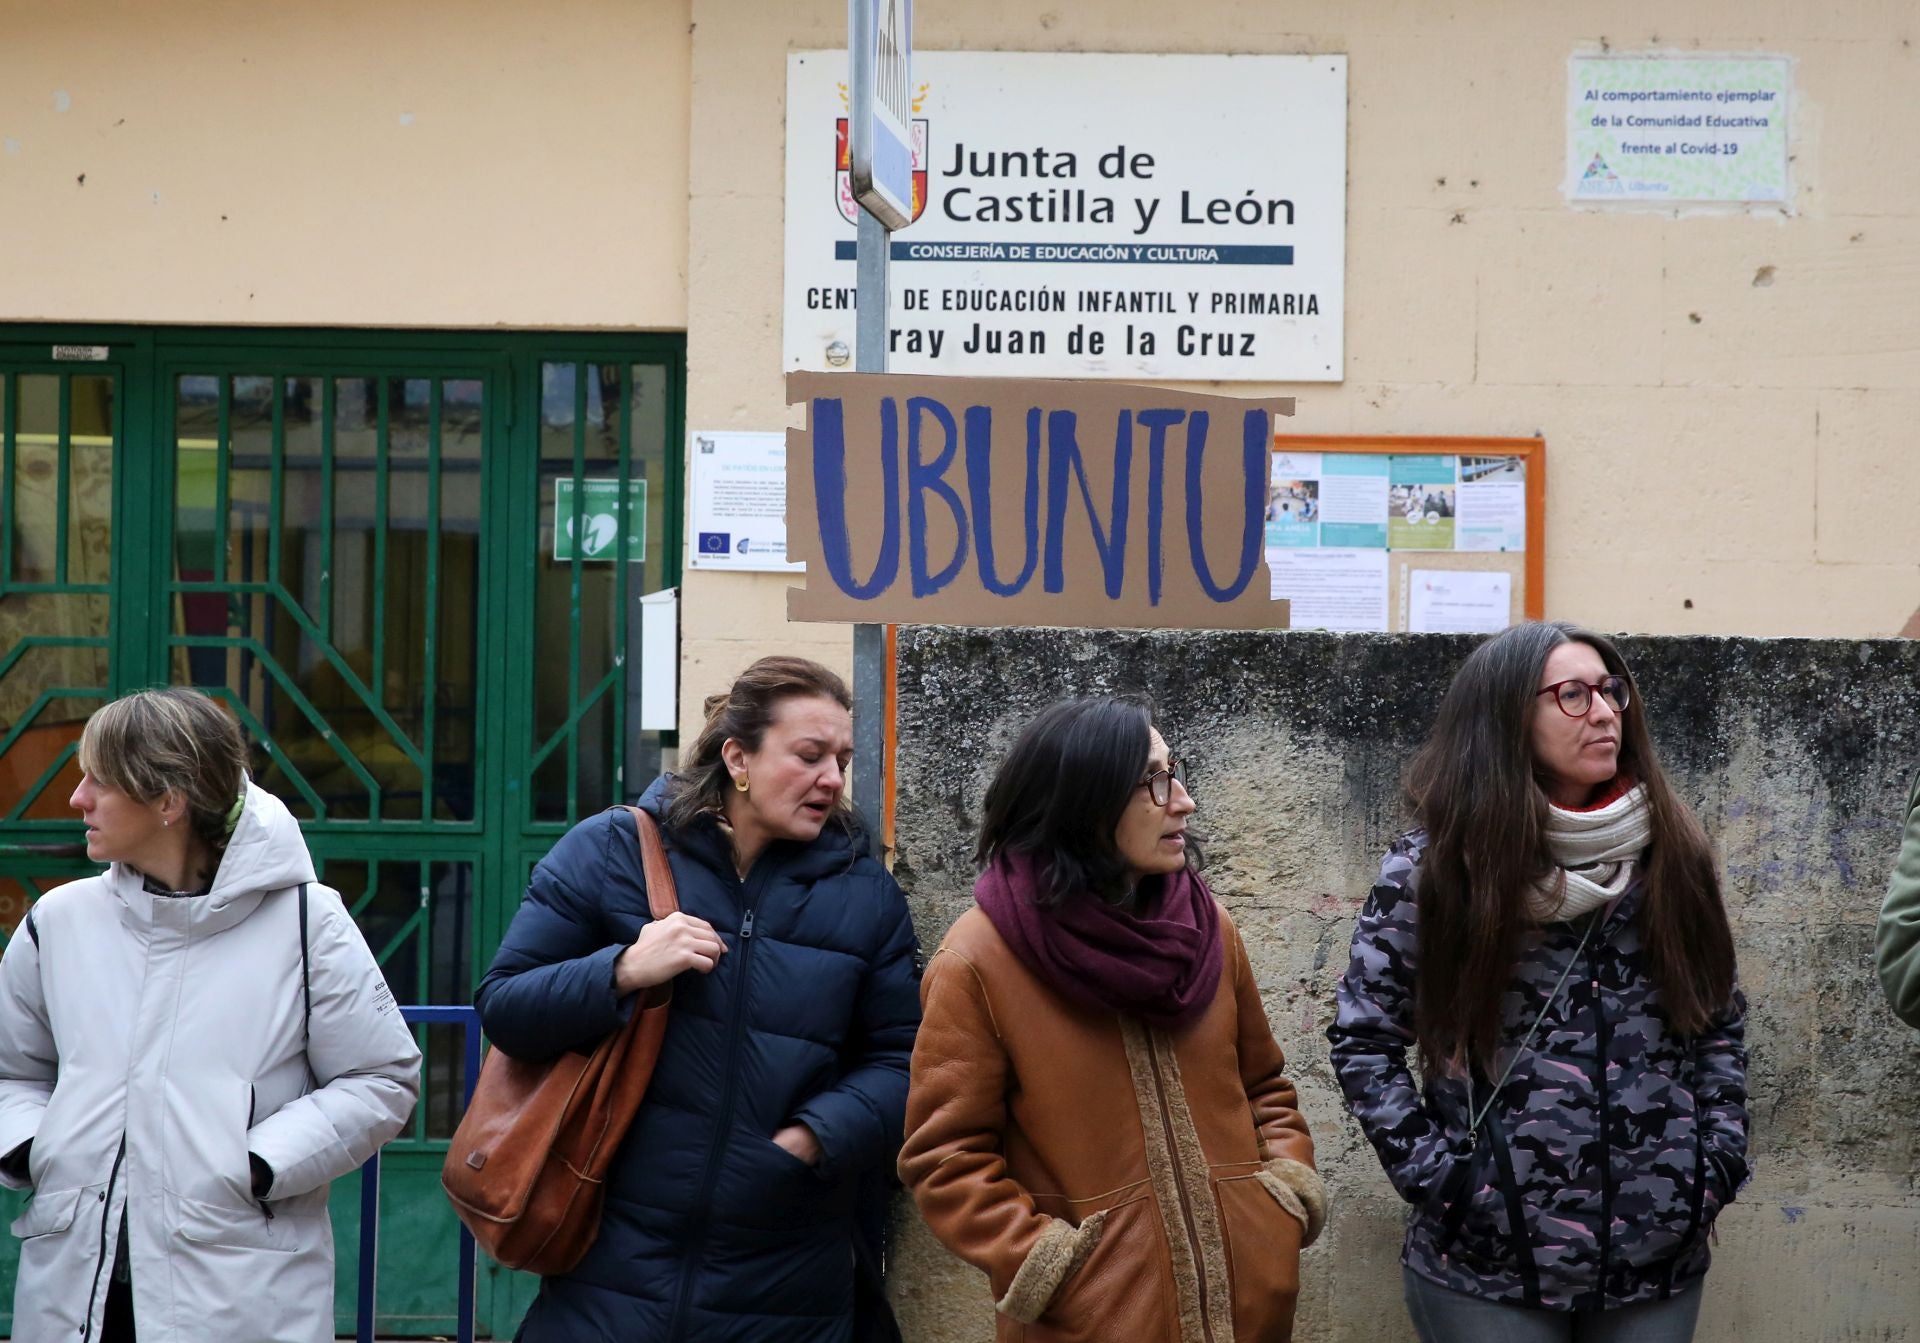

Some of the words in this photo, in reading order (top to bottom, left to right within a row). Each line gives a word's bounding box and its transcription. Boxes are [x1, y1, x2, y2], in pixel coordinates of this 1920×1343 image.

[1585, 89, 1599, 101] Al
[1602, 89, 1713, 104] comportamiento
[1716, 89, 1777, 104] ejemplar
[1591, 114, 1608, 127] de
[1611, 114, 1623, 127] la
[1626, 114, 1702, 127] Comunidad
[1706, 115, 1769, 128] Educativa
[942, 143, 1078, 179] Junta
[1098, 145, 1156, 180] de
[1621, 142, 1662, 154] frente
[1665, 143, 1677, 154] al
[1680, 142, 1739, 155] Covid-19
[942, 188, 1115, 224] Castilla
[1132, 198, 1161, 234] y
[1181, 190, 1295, 226] León
[910, 244, 1005, 259] CONSEJERÍA
[1009, 246, 1030, 259] DE
[1036, 244, 1129, 261] EDUCACIÓN
[1132, 247, 1143, 260] Y
[1147, 248, 1219, 262] CULTURA
[808, 288, 891, 310] CENT
[904, 289, 929, 310] DE
[943, 285, 1066, 312] EDUCACIÓN
[1078, 290, 1177, 314] INFANTIL
[1187, 292, 1200, 314] Y
[1212, 292, 1319, 316] PRIMARIA
[889, 329, 945, 359] ray
[963, 323, 1046, 355] Juan
[1067, 324, 1105, 355] de
[1127, 324, 1156, 356] la
[1177, 324, 1256, 357] Cruz
[813, 396, 1268, 607] UBUNTU
